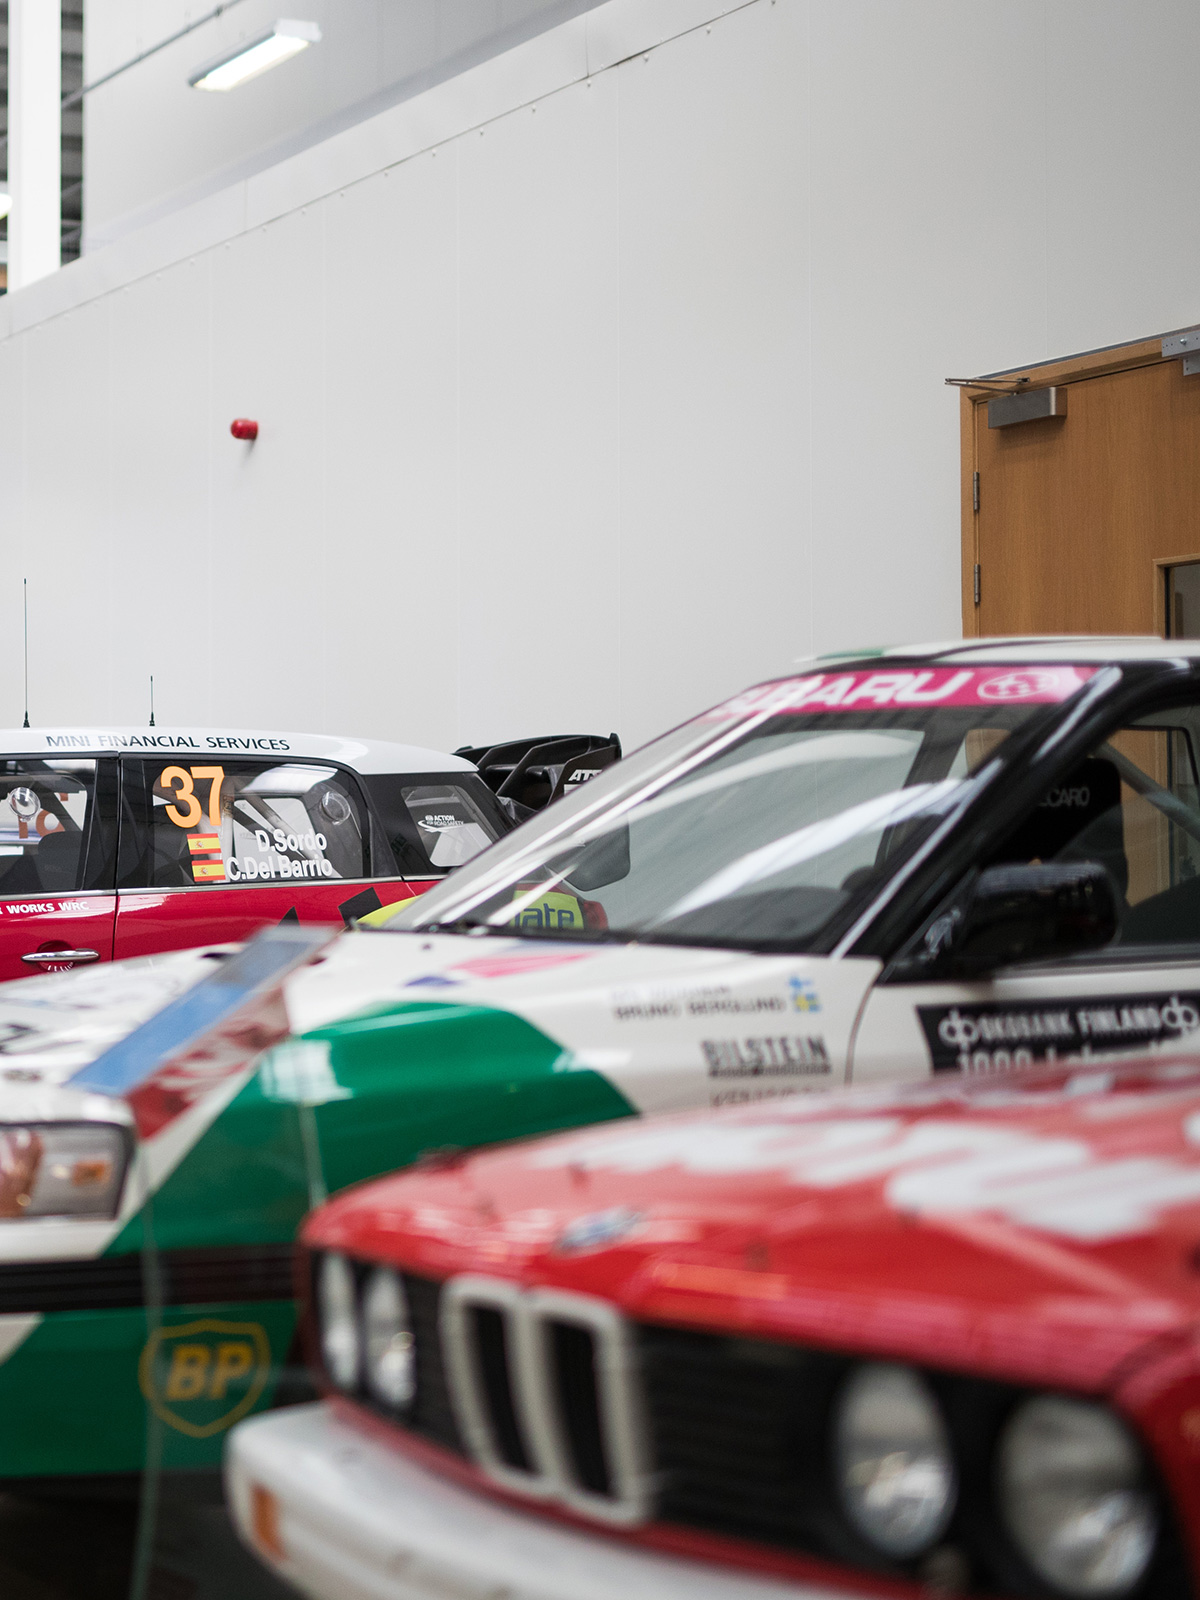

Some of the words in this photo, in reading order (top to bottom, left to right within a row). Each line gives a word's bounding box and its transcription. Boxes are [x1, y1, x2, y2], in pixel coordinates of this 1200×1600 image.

[46, 735, 91, 747] MINI
[99, 735, 200, 748] FINANCIAL
[206, 736, 290, 750] SERVICES
[160, 765, 225, 828] 37
[1040, 787, 1090, 807] CARO
[255, 829, 327, 852] D.Sordo
[226, 855, 276, 881] C.Del
[279, 854, 333, 879] Barrio
[6, 902, 55, 914] WORKS
[58, 901, 90, 911] WRC
[701, 1034, 830, 1068] BILSTEIN
[166, 1341, 253, 1401] BP
